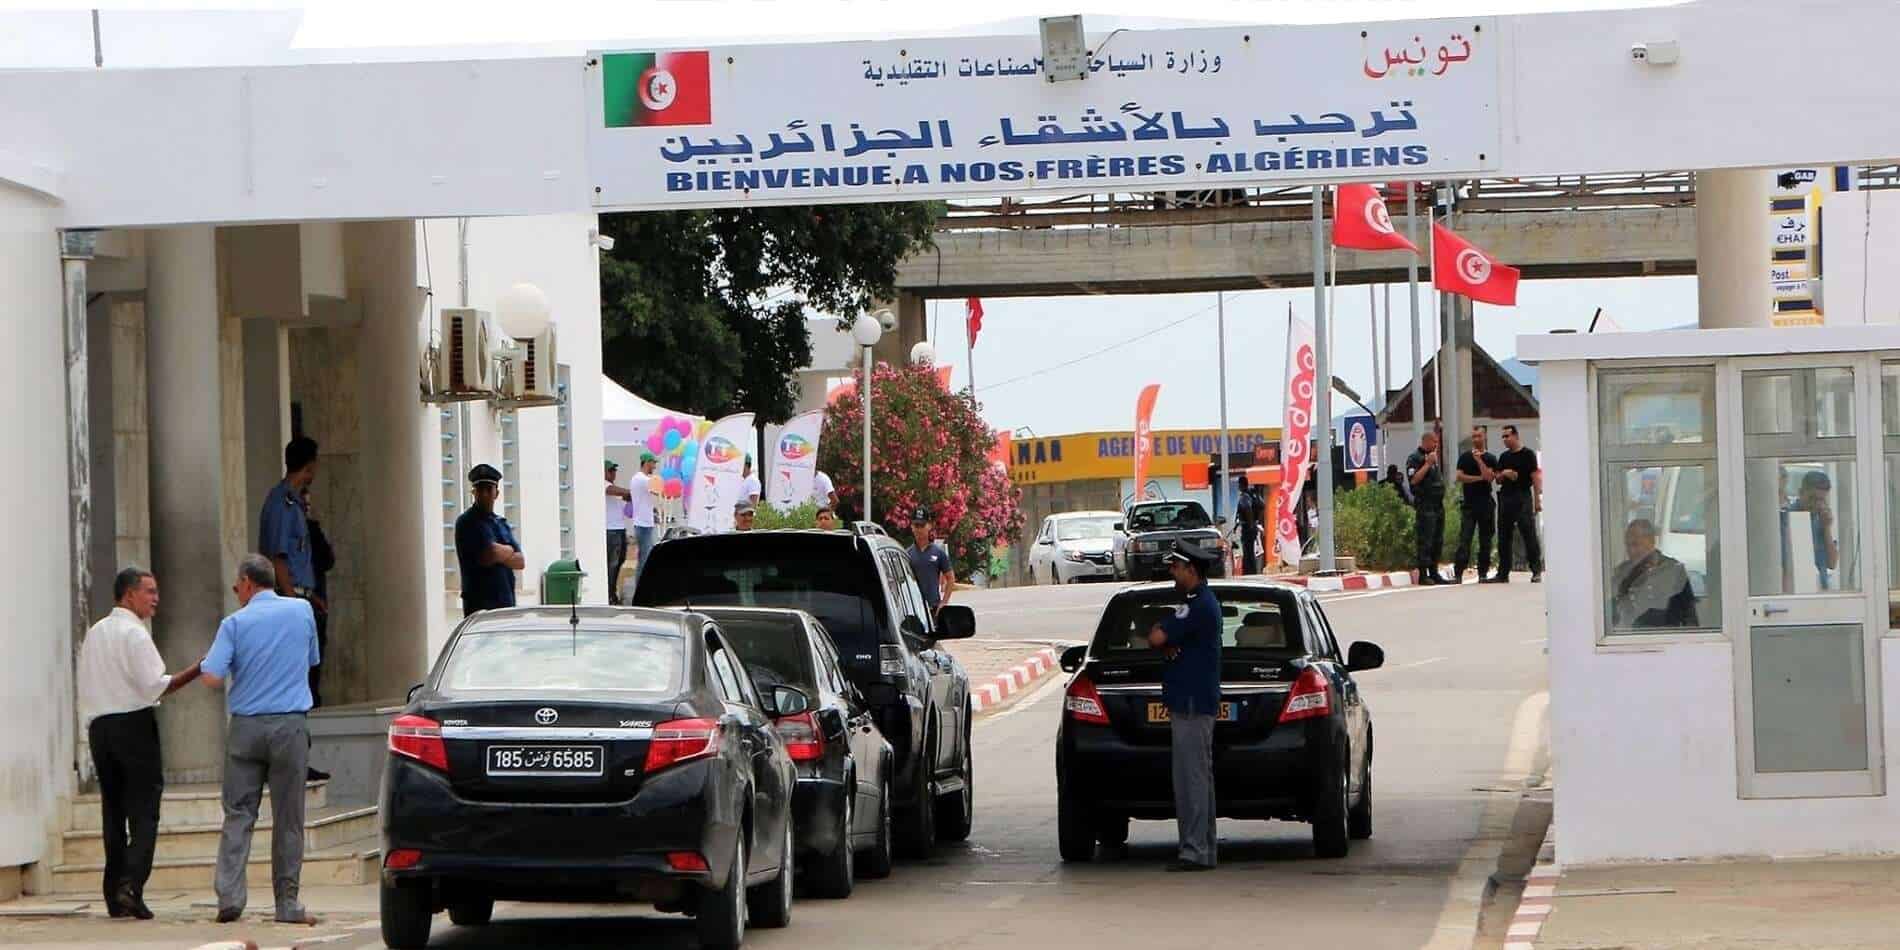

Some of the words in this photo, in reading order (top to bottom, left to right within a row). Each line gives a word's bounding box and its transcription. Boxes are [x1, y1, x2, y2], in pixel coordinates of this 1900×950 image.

[863, 58, 946, 87] التقليدية
[1088, 53, 1153, 78] السياح
[1166, 49, 1223, 74] وزارة
[978, 102, 1231, 150] بالأشقاء
[1255, 100, 1418, 143] ترحب
[659, 118, 953, 165] الجزائريين
[666, 164, 893, 193] BIENVENUE
[903, 164, 930, 184] A
[940, 160, 1025, 183] NOS
[1036, 153, 1186, 179] FRÈRES
[1205, 144, 1429, 174] ALGÉRIENS
[1166, 436, 1187, 456] DE
[443, 719, 468, 727] TOYOTA
[495, 750, 523, 769] 185
[553, 750, 595, 769] 6585
